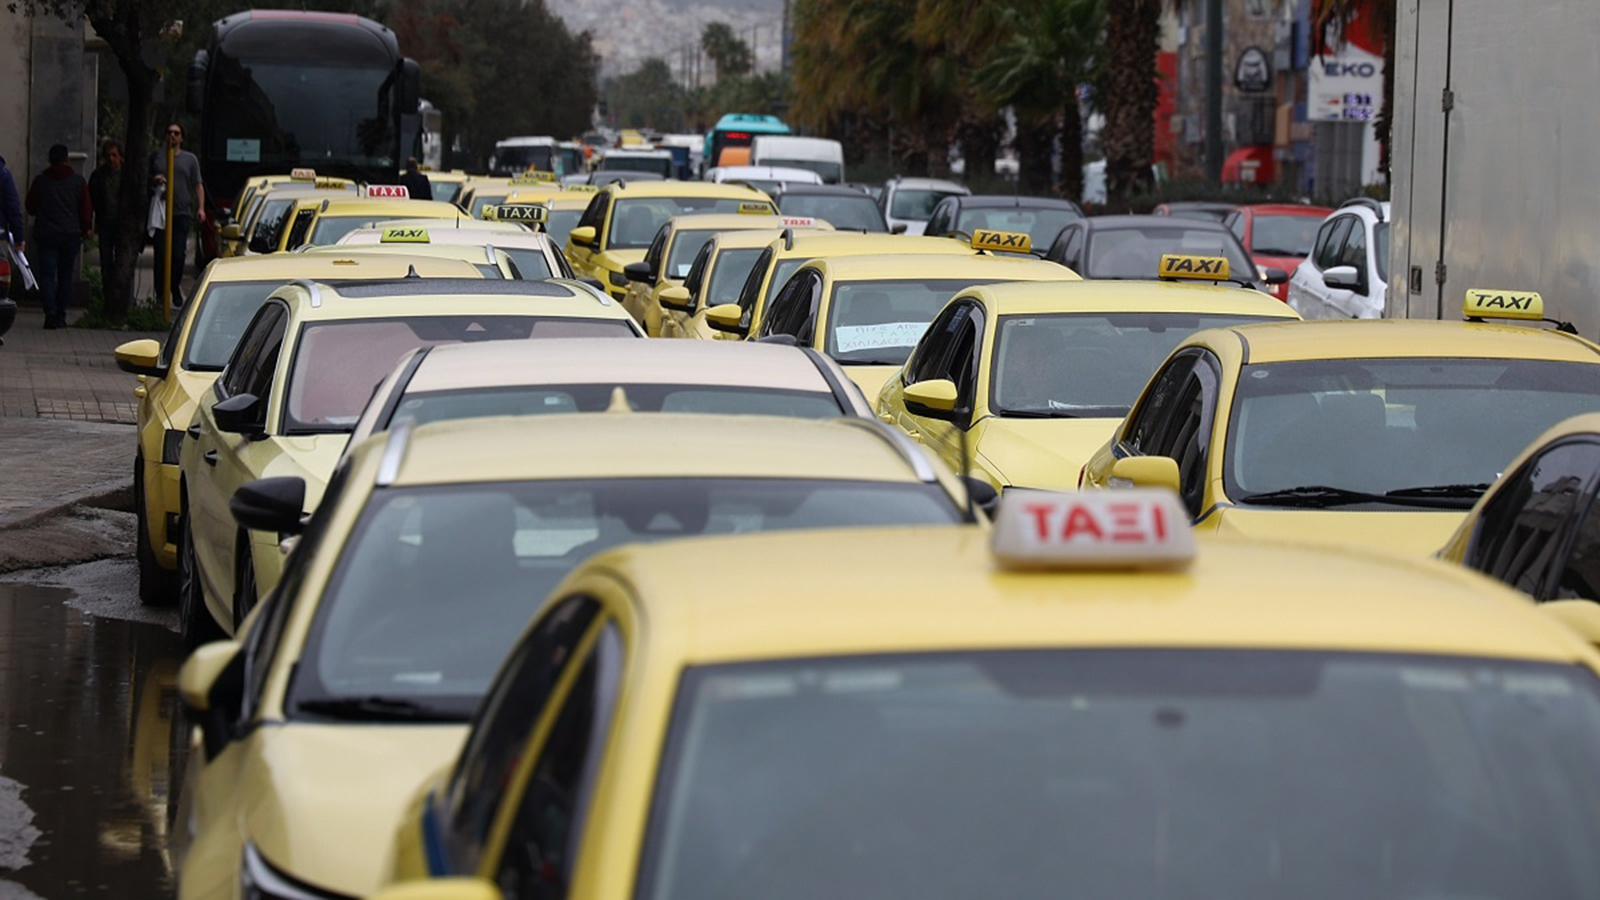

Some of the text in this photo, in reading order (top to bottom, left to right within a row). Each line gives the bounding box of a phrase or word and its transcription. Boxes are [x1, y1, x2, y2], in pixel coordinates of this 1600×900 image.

[1325, 63, 1375, 77] EKO
[371, 187, 405, 197] TAXI
[503, 207, 538, 219] TAXI
[388, 229, 423, 238] TAXI
[979, 231, 1027, 247] TAXI
[1166, 258, 1223, 274] TAXI
[1475, 294, 1533, 310] TAXI
[1024, 502, 1168, 543] ΤΑΞΙ
